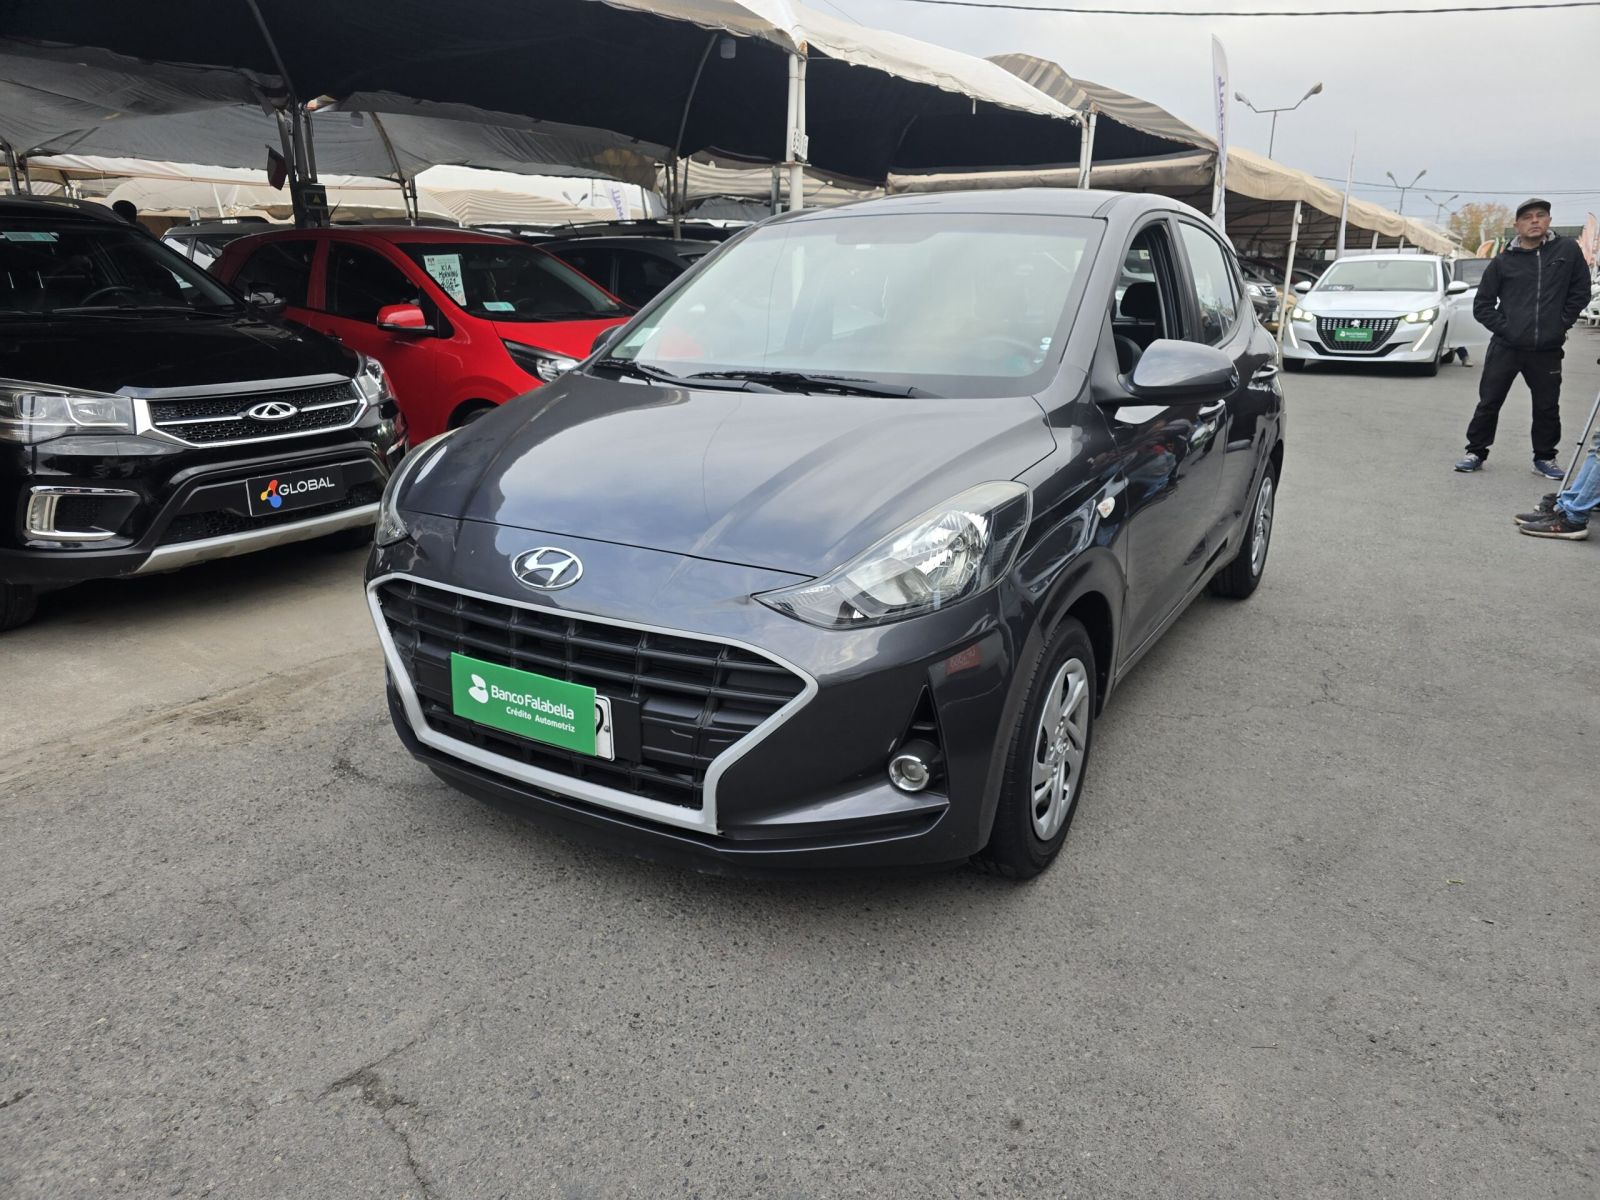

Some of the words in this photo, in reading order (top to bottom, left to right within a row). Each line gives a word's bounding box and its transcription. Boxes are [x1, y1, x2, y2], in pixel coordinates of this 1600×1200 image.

[279, 477, 335, 495] GLOBAL
[506, 706, 532, 720] Crédito
[535, 714, 575, 733] Automotriz
